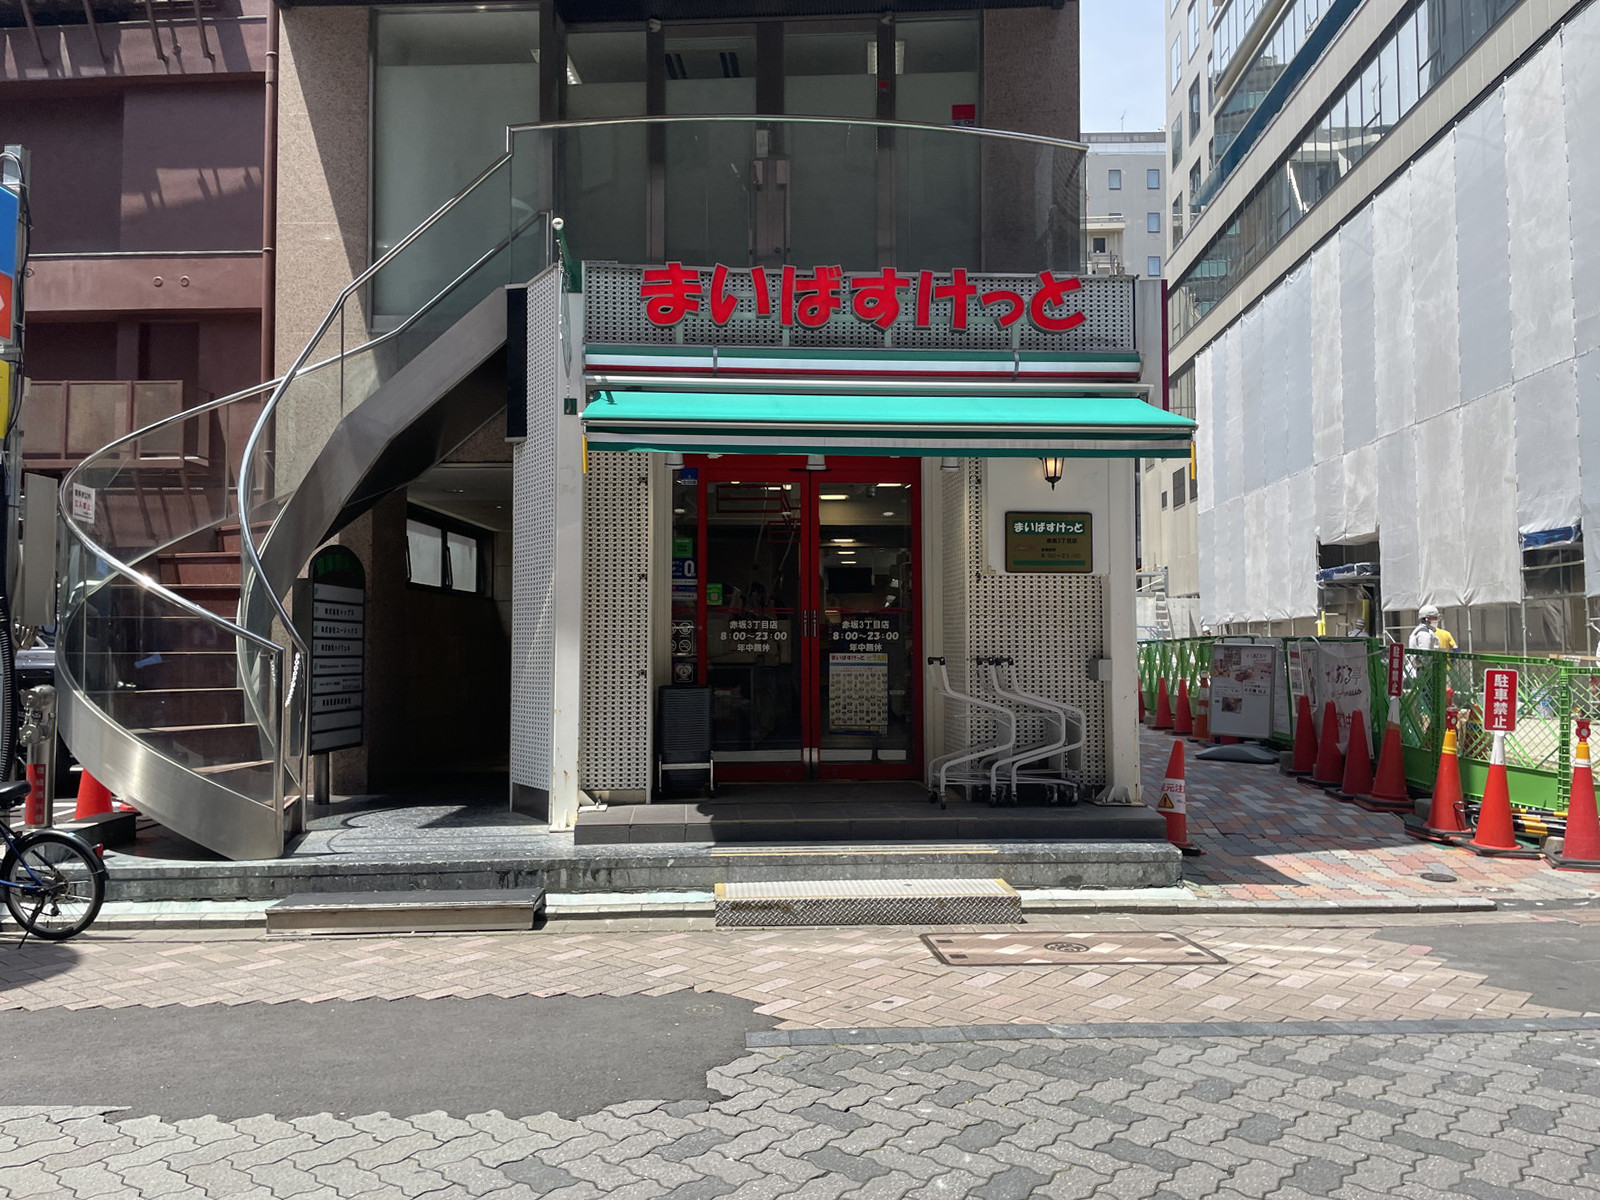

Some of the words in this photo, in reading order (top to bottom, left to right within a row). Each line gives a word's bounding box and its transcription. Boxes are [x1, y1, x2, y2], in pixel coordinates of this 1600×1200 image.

[640, 261, 1086, 333] まいばすけっと
[1014, 522, 1083, 532] まいばすけっと
[729, 620, 778, 629] 赤坂3丁目店
[842, 620, 890, 629] 赤坂3丁目店
[737, 643, 770, 652] 年中無休
[849, 643, 882, 652] 年中無休
[1391, 646, 1400, 693] 駐車禁止
[1492, 674, 1509, 728] 駐車禁止
[1161, 783, 1185, 793] 元注
